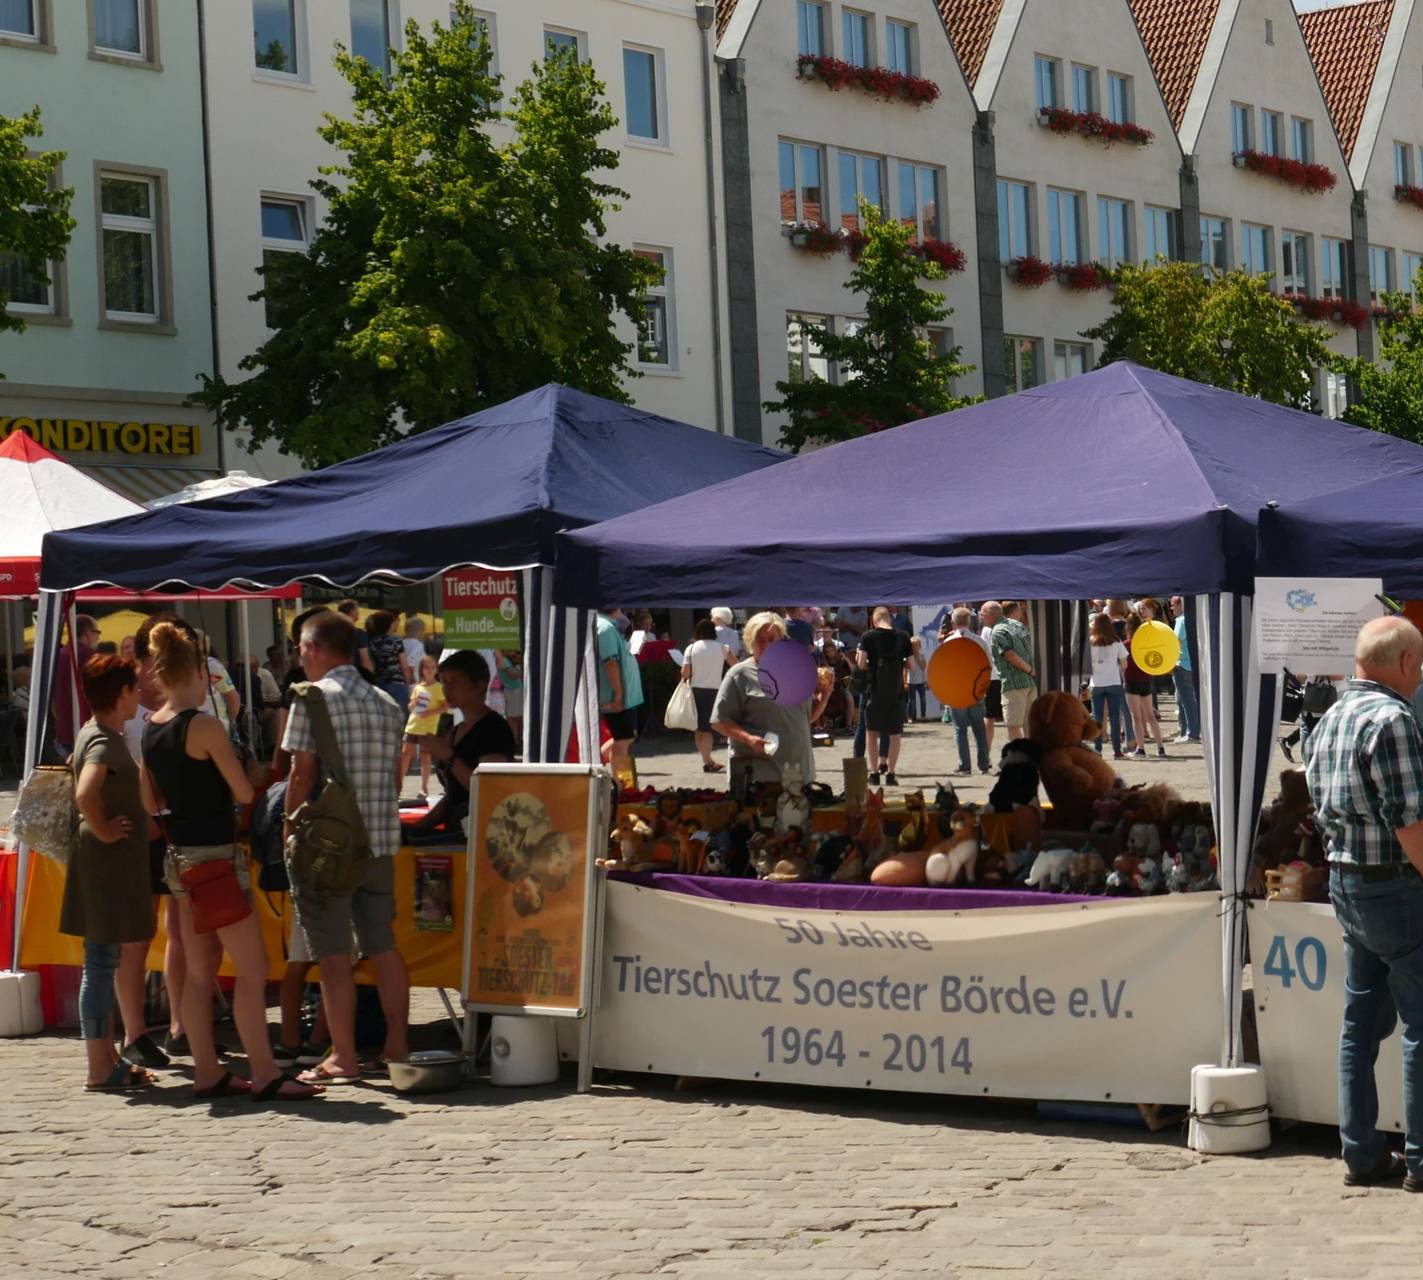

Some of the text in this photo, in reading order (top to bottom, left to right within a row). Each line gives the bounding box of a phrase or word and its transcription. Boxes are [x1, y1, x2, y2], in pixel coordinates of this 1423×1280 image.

[445, 576, 517, 596] Tierschutz
[773, 917, 933, 951] 50 Jahre
[612, 955, 1134, 1019] Tierschutz Soester Börde e.V.
[1264, 936, 1327, 990] 40
[760, 1026, 974, 1076] 1964 - 2014
